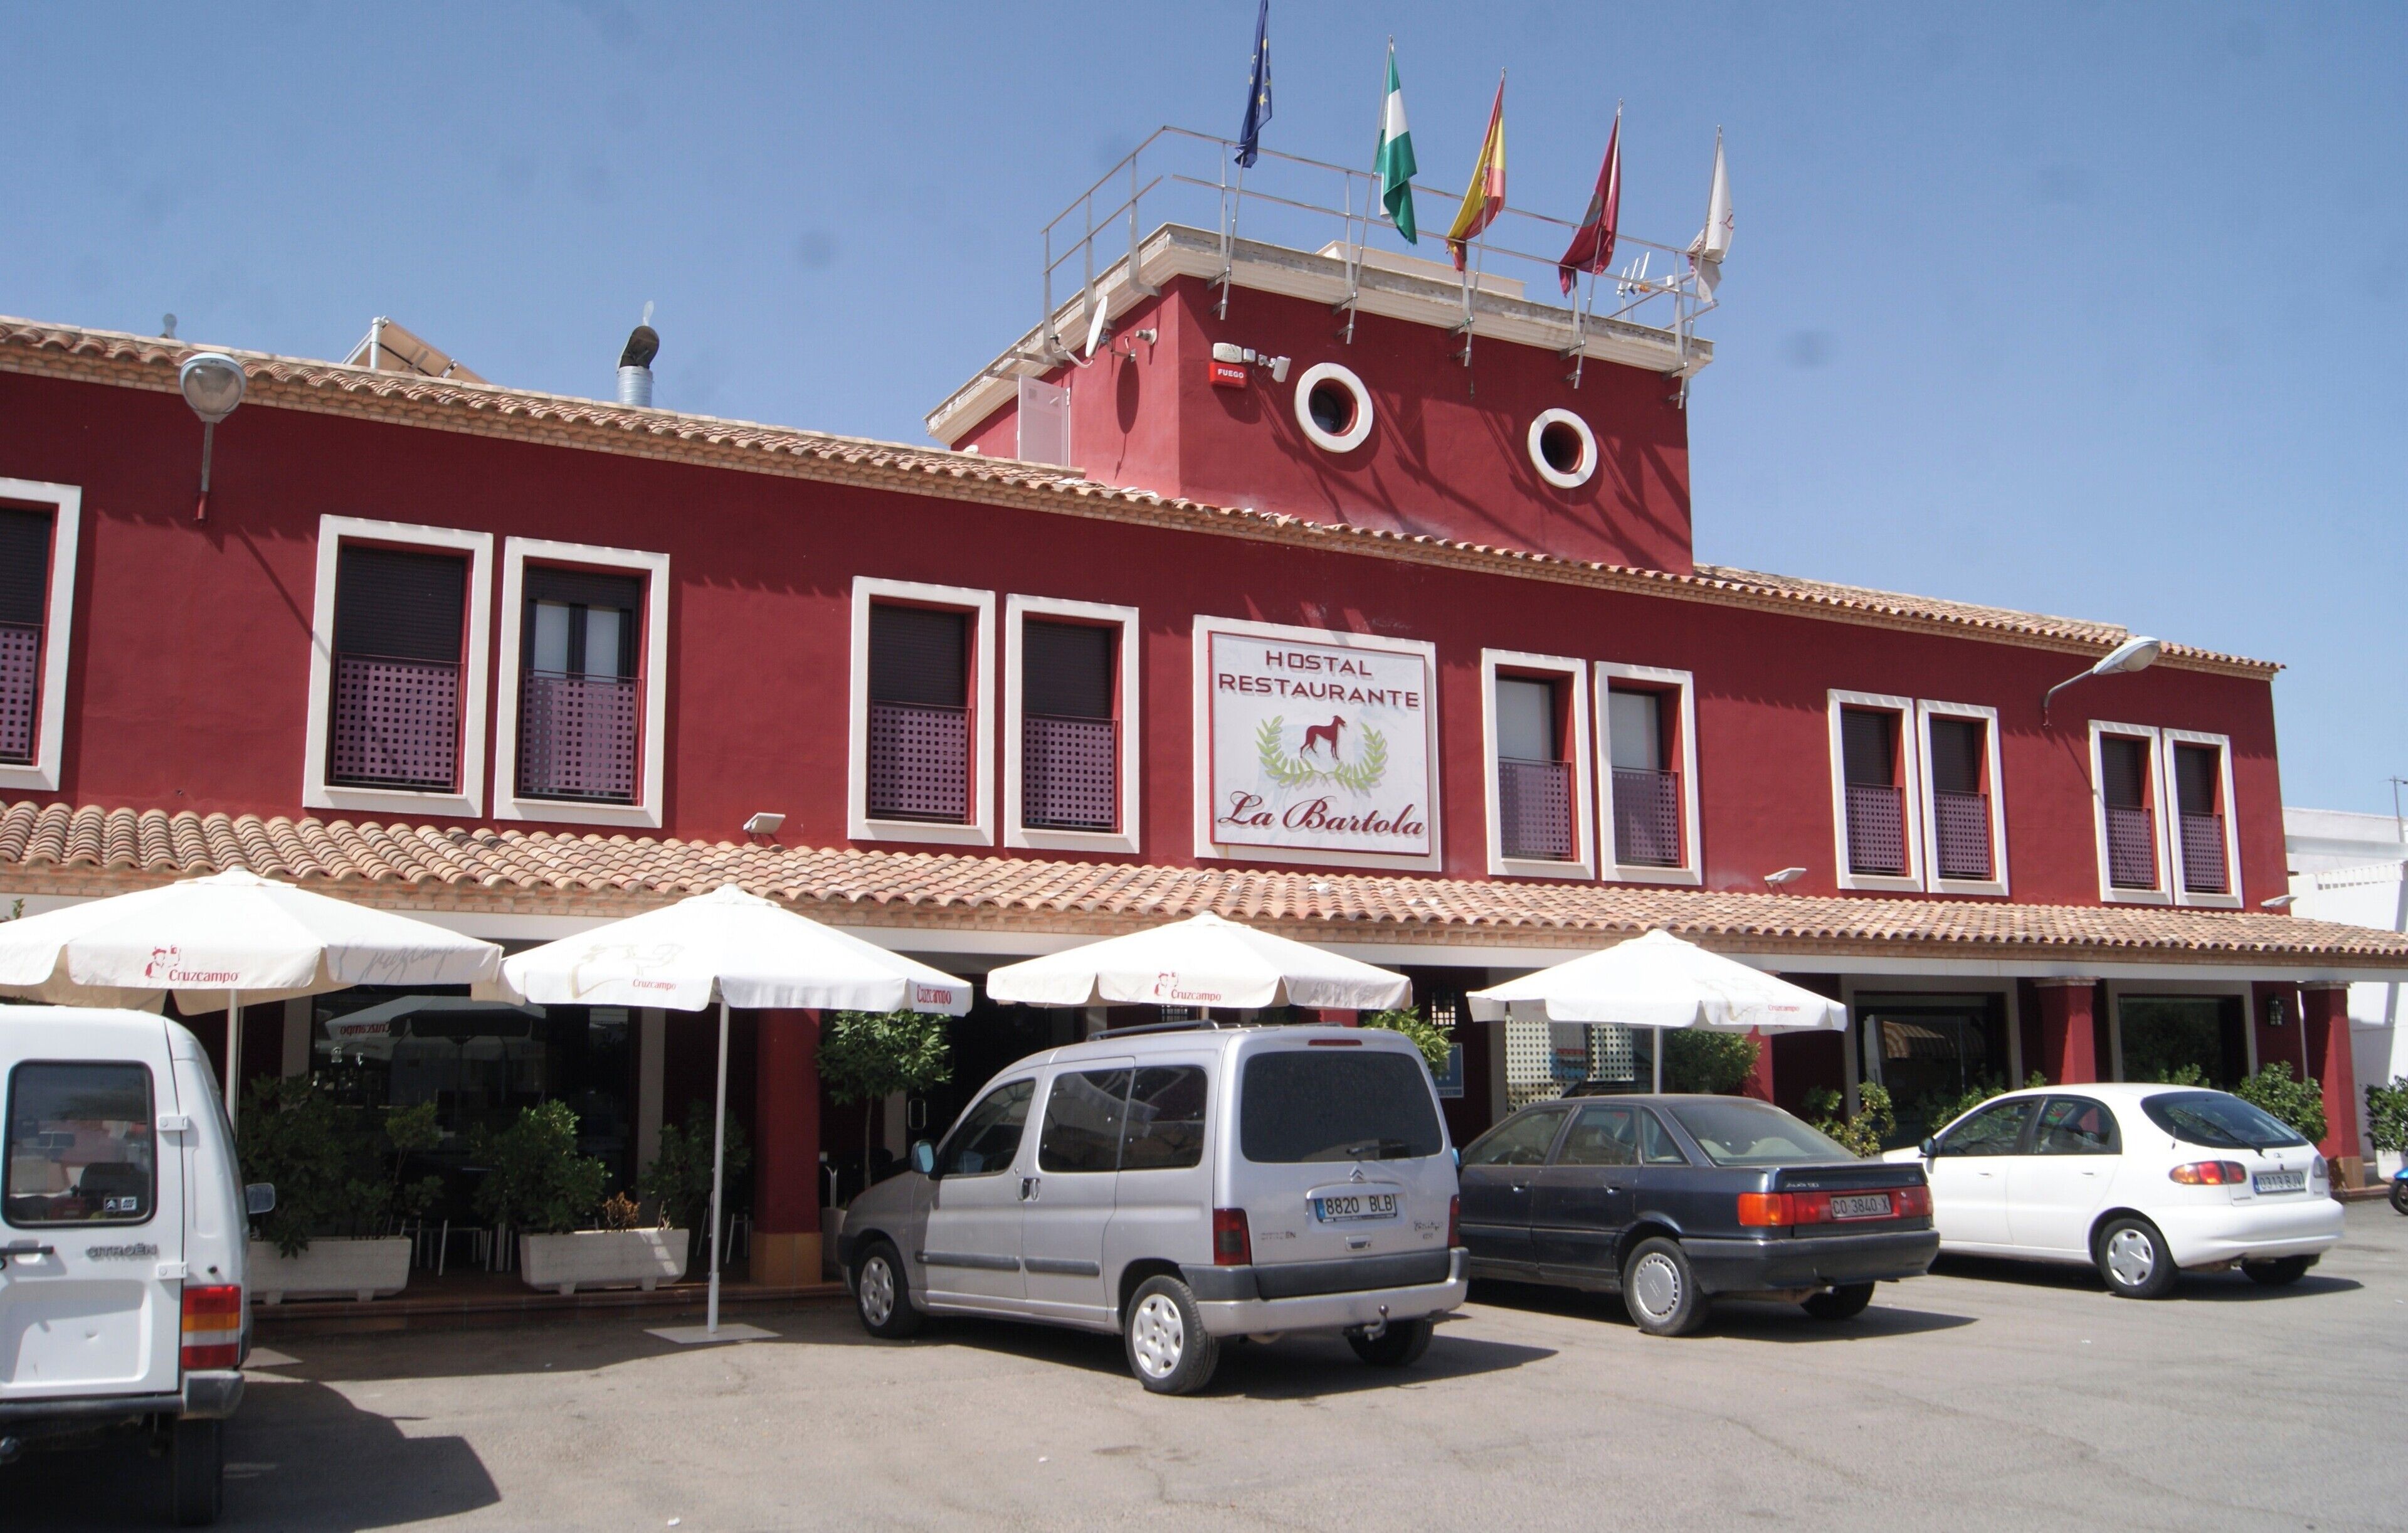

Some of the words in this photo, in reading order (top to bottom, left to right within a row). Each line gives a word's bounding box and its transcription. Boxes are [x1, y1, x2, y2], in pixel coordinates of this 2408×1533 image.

[1217, 368, 1244, 379] FUEGO
[1265, 650, 1372, 677] HOSTAL
[1218, 672, 1419, 708] RESTAURANTE
[1218, 790, 1275, 827] La
[1282, 795, 1425, 835] Bartola
[169, 969, 239, 984] Cruzcampo
[633, 979, 677, 992] Cruzcampo
[1171, 989, 1222, 1002] Cruzcampo
[1326, 1197, 1360, 1215] 8820
[1369, 1194, 1393, 1212] BLB
